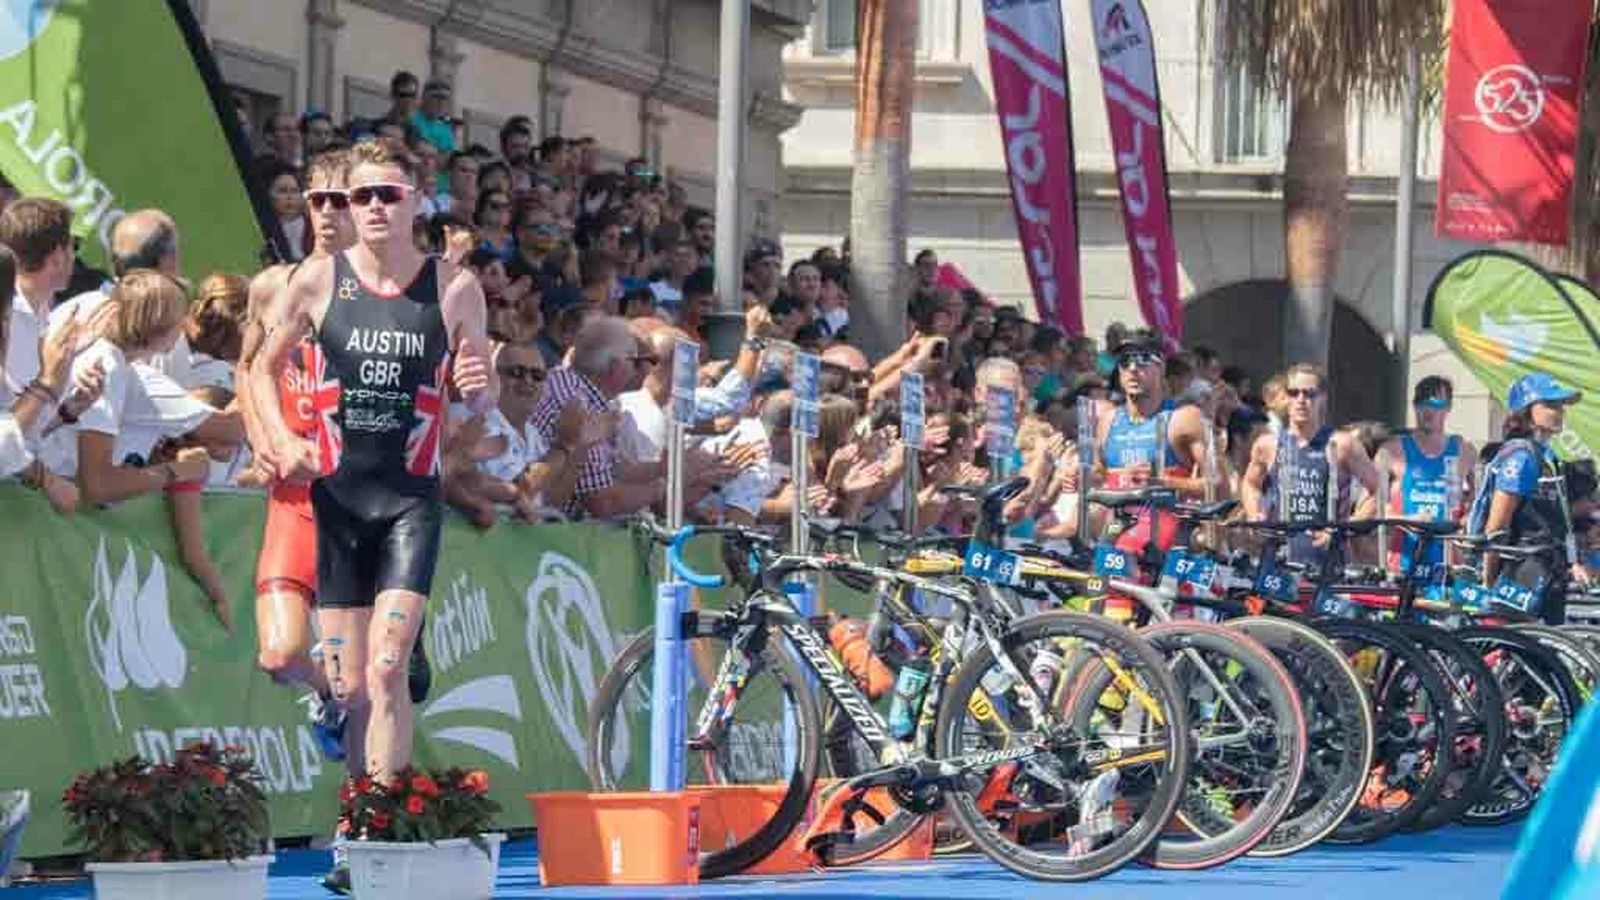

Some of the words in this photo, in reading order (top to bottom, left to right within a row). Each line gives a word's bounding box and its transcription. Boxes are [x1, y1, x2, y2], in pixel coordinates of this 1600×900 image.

[346, 328, 425, 357] AUSTIN
[359, 359, 402, 387] GBR
[971, 551, 992, 571] 61
[1103, 552, 1126, 570] 59
[1263, 574, 1282, 591] 55
[1323, 598, 1341, 615] 53
[782, 622, 886, 741] SPECIALIZED
